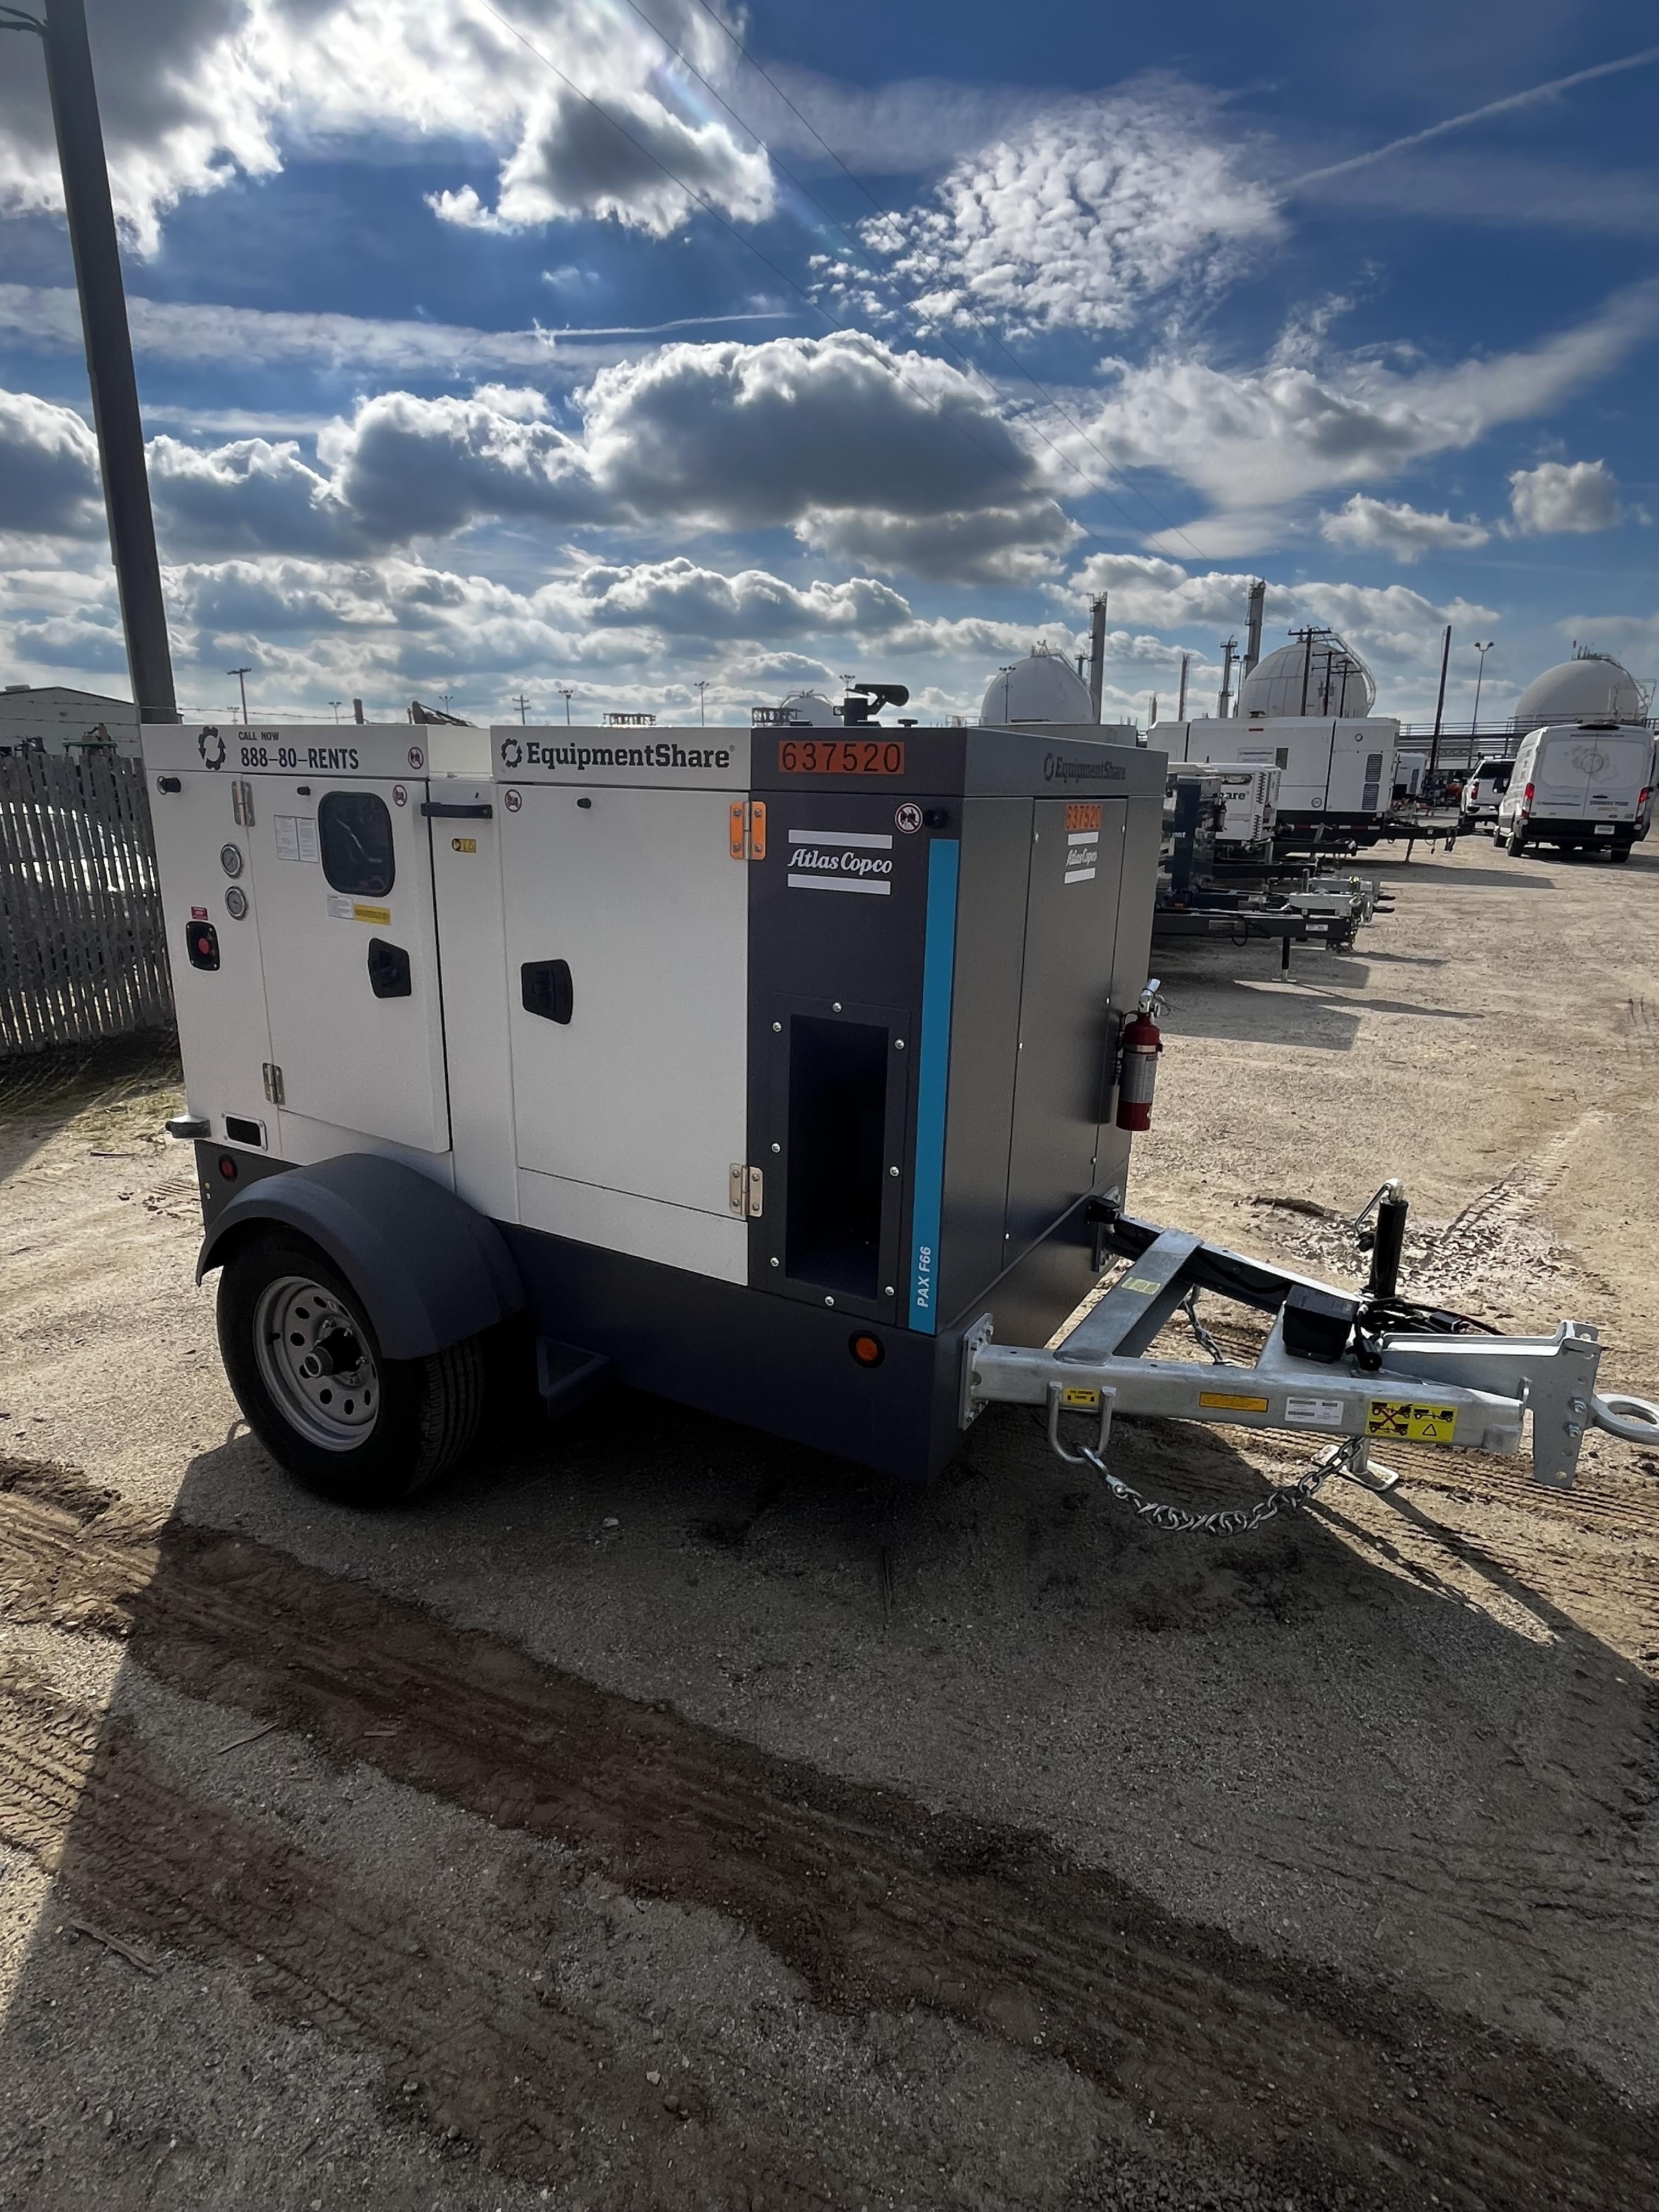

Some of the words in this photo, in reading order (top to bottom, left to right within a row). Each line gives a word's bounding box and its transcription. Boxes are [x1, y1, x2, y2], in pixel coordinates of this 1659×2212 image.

[238, 731, 257, 741] CALL
[261, 731, 279, 741] NOW
[241, 747, 359, 769] 888-80-RENTS
[526, 742, 730, 770] EquipmentShare
[782, 742, 901, 772] 637520
[1055, 756, 1126, 783] EquipmentShare
[1066, 805, 1101, 829] 637520
[919, 1246, 931, 1272] F66
[917, 1276, 929, 1308] PAX
